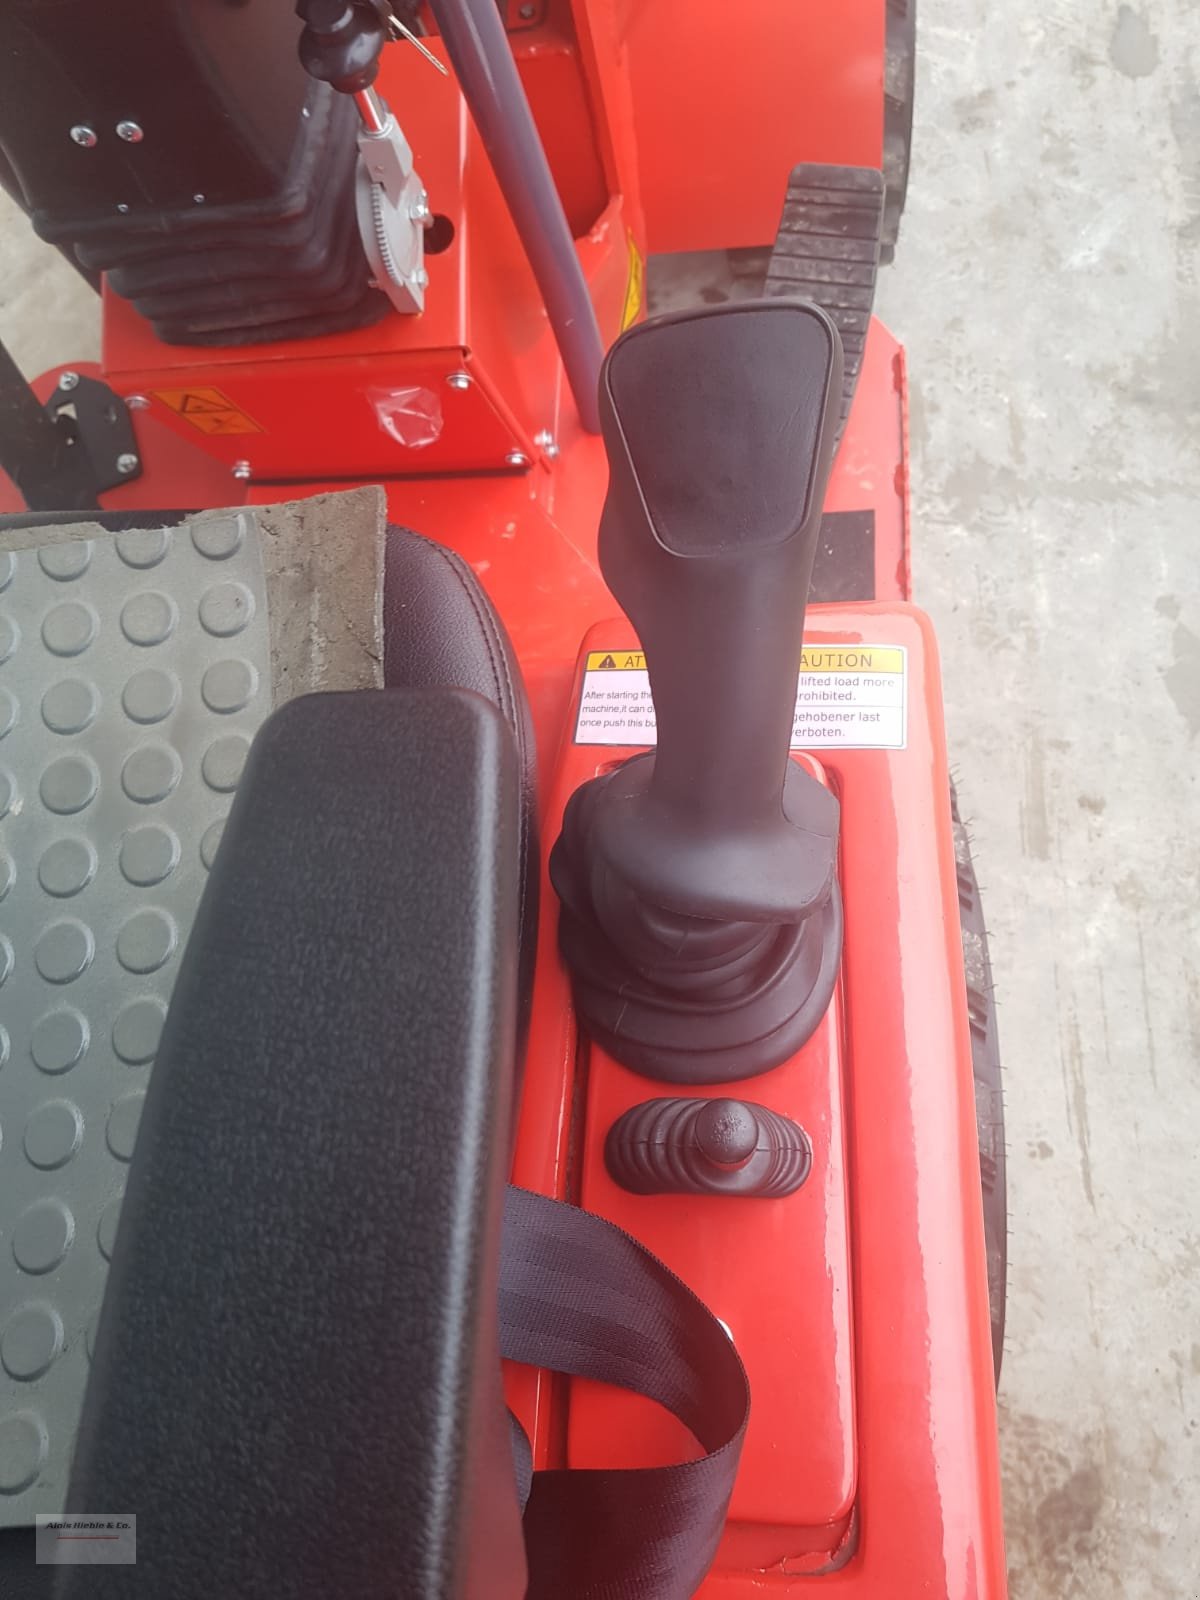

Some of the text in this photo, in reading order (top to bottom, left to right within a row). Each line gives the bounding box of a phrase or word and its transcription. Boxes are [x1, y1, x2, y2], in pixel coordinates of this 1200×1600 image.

[624, 655, 644, 668] AT
[799, 654, 872, 667] AUTION
[801, 677, 895, 687] lifted load more
[584, 691, 606, 700] After
[607, 691, 638, 701] starting
[799, 691, 857, 701] rohibited.
[629, 705, 645, 713] can
[859, 712, 881, 722] last
[580, 719, 657, 728] once push this bu
